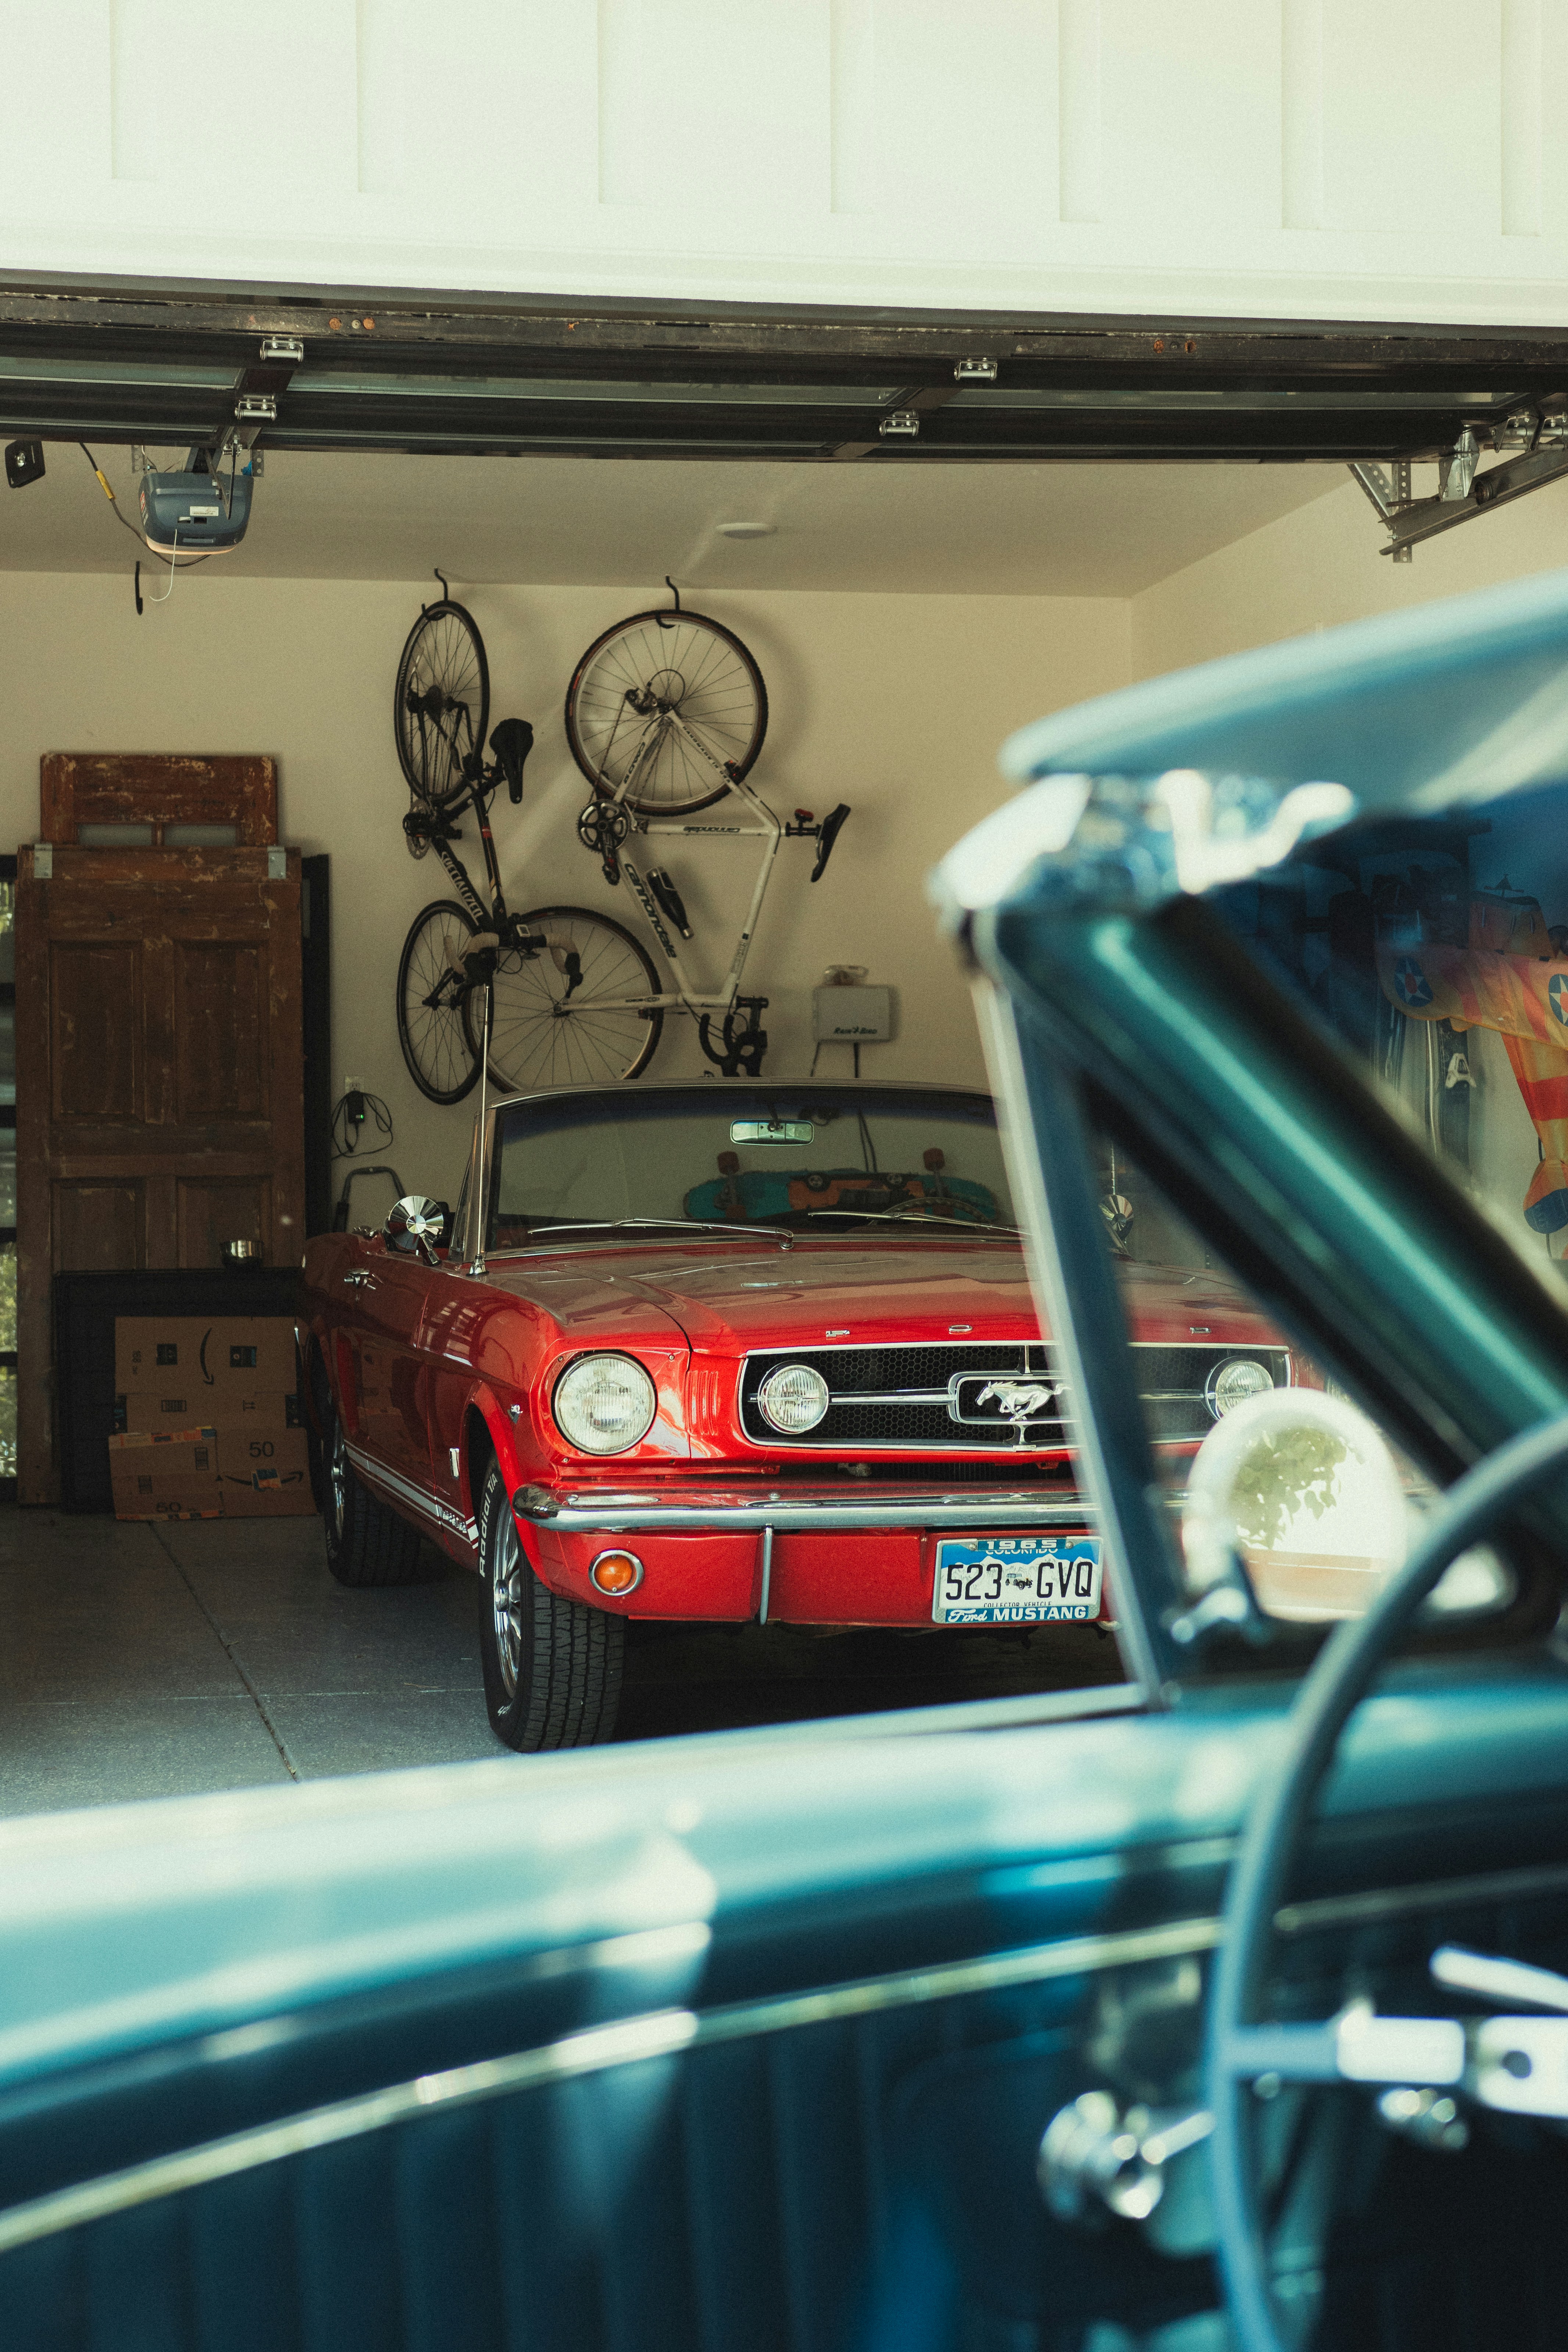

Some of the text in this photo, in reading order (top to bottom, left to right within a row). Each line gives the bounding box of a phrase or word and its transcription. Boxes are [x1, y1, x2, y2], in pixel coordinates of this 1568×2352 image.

[683, 825, 741, 834] cannondale
[440, 851, 483, 919] SPECIALIZED
[624, 863, 677, 959] cannondale
[249, 1441, 274, 1458] 50
[479, 1473, 498, 1578] Radial T/A
[986, 1539, 1057, 1550] 1965
[945, 1561, 1093, 1601] 523 GVQ
[947, 1606, 1087, 1622] Ford MUSTANG
